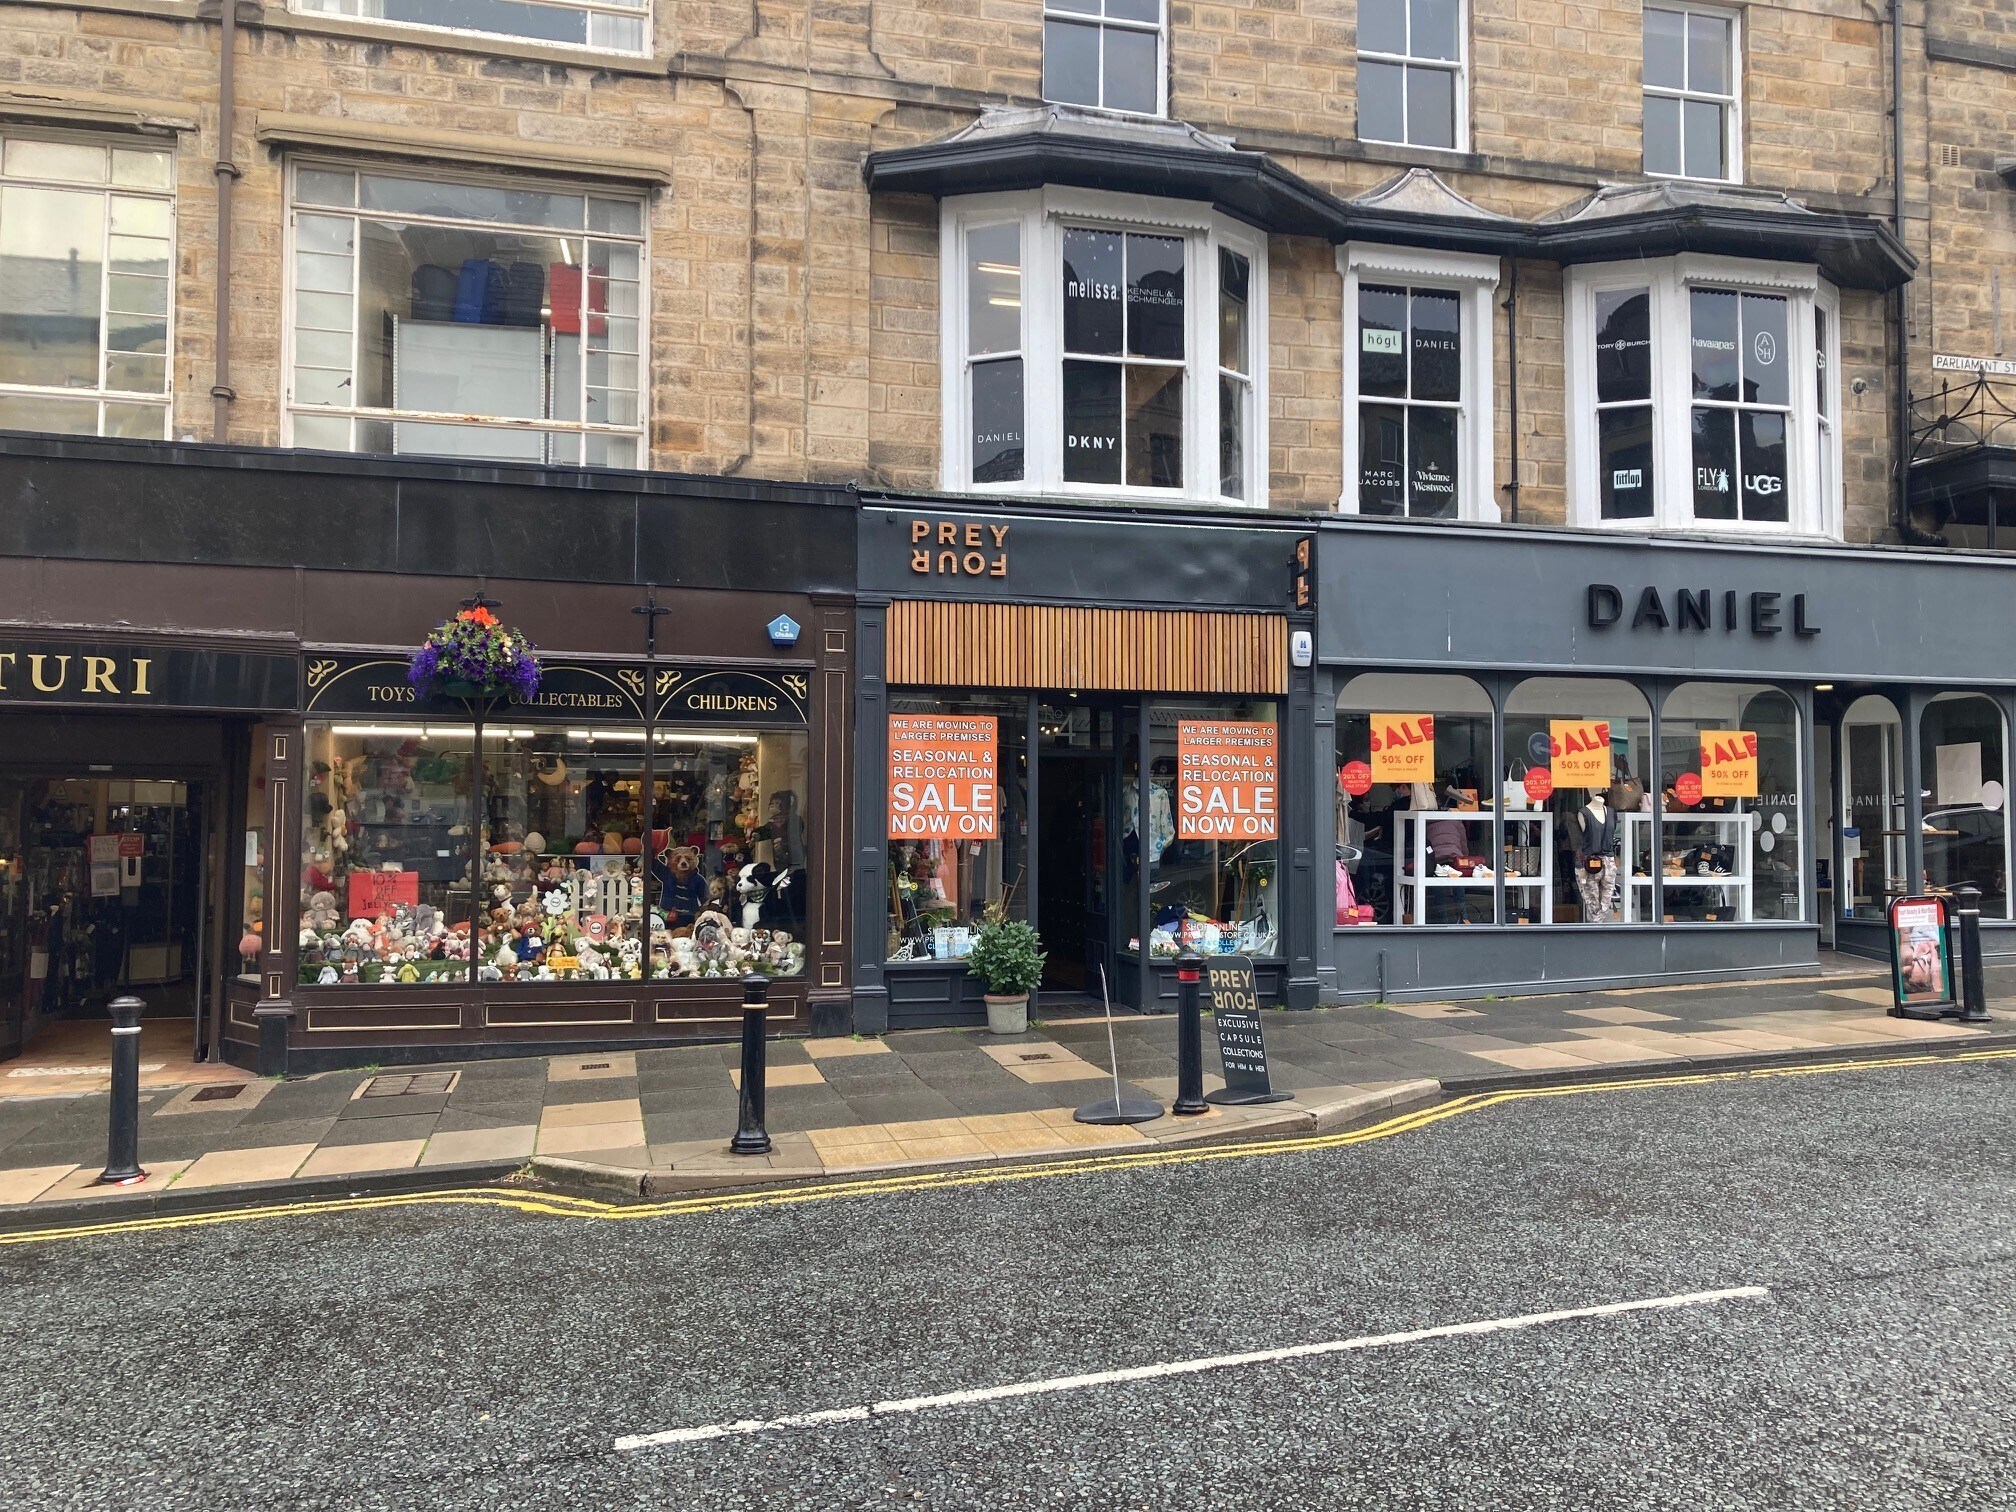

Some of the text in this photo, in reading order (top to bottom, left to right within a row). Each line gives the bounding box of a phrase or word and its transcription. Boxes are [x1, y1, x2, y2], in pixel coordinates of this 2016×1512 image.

[1127, 287, 1174, 298] KENNEL &
[1127, 295, 1183, 306] SCHMENGER
[1416, 339, 1456, 350] DANIEL
[977, 432, 1021, 444] DANIEL
[1068, 434, 1115, 450] DKNY
[1364, 470, 1394, 479] MARC
[1415, 470, 1451, 482] Vivienne
[1616, 470, 1640, 488] fitflop
[1698, 468, 1718, 486] FLY
[1359, 478, 1400, 487] JACOBS
[1411, 480, 1454, 493] Westwood
[1745, 474, 1781, 495] UGG
[911, 520, 1011, 549] PREY
[911, 549, 1007, 577] FOUR
[1587, 583, 1822, 635] DANIEL
[367, 686, 415, 702] TOYS
[508, 692, 623, 708] COLLECTABLES
[687, 694, 778, 712] CHILDRENS
[893, 720, 993, 731] WE ARE MOVING TO
[1182, 726, 1274, 736] WE ARE MOVING TO
[894, 732, 991, 742] LARGER PREMISES
[1370, 717, 1434, 752] SALE
[1550, 723, 1609, 757] SALE
[1184, 738, 1272, 747] LARGER PREMISES
[893, 750, 993, 763] SEASONAL &
[1701, 734, 1757, 767] SALE
[1182, 754, 1274, 767] SEASONAL &
[1382, 755, 1424, 763] 50% OFF
[1561, 761, 1601, 769] 50% OFF
[893, 766, 993, 779] RELOCATION
[1183, 770, 1274, 782] RELOCATION
[1711, 770, 1749, 778] 50% OFF
[892, 782, 993, 812] SALE
[1182, 785, 1275, 814] SALE
[1848, 794, 1899, 806] DANIEL
[891, 813, 993, 834] NOW ON
[1182, 815, 1275, 834] NOW ON
[373, 874, 397, 885] 10%
[376, 885, 397, 894] OFF
[1213, 923, 1242, 931] ONLINE
[1209, 969, 1251, 988] PREY
[1213, 991, 1257, 1011] FOUR
[1218, 1018, 1259, 1030] EXCLUSIVE
[1220, 1033, 1262, 1044] CAPSULE
[1223, 1046, 1264, 1059] COLLECTIONS
[1225, 1061, 1236, 1069] FOR
